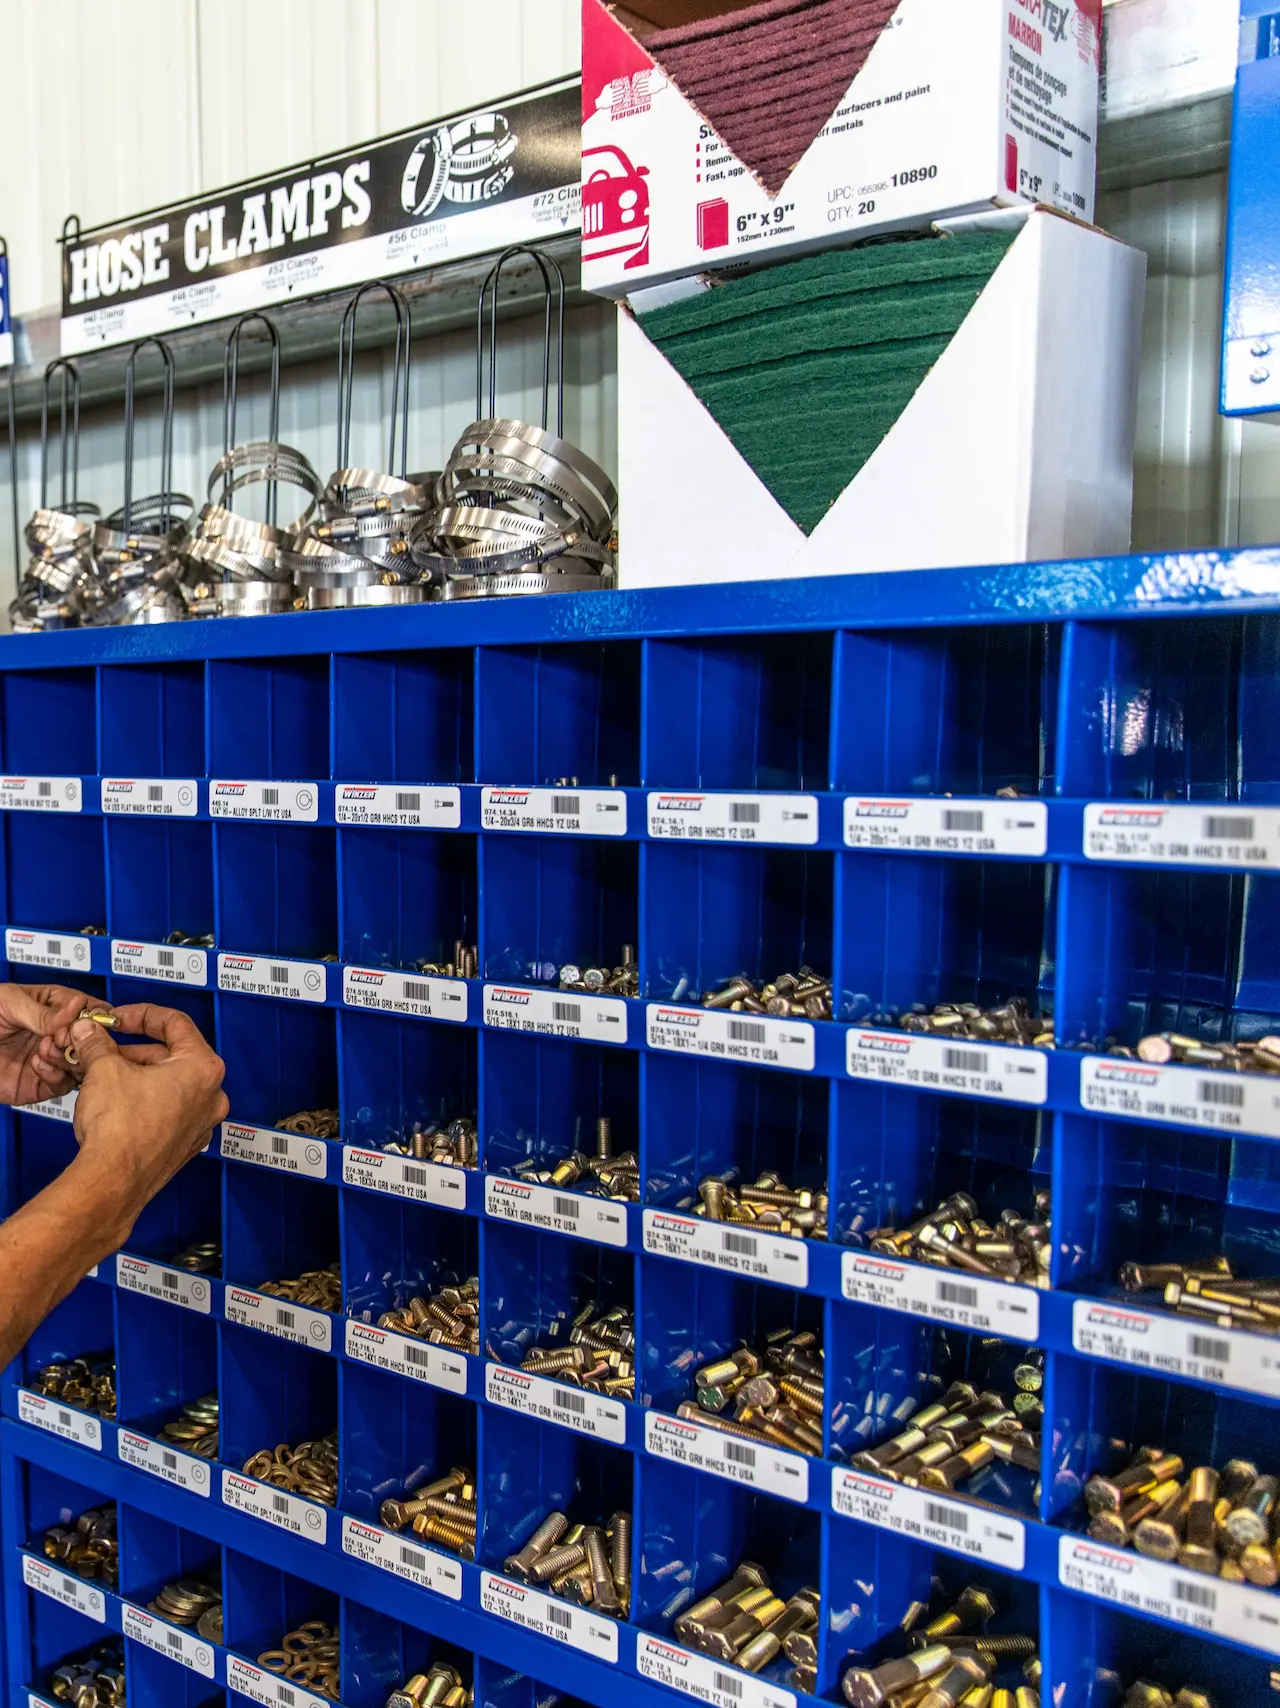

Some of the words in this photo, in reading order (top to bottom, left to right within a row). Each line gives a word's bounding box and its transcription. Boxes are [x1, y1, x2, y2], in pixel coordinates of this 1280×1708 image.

[1008, 11, 1042, 56] MARRON
[836, 99, 882, 117] surfacers
[884, 92, 902, 104] and
[904, 84, 930, 100] paint
[610, 104, 652, 121] PERFORATED
[832, 119, 864, 134] metals
[706, 144, 718, 153] For
[706, 155, 736, 168] Remov
[706, 170, 726, 183] Fast,
[533, 193, 554, 208] #72
[828, 186, 854, 203] UPC:
[827, 206, 854, 222] QTY:
[858, 200, 875, 215] 20
[70, 222, 170, 304] HOSE
[184, 160, 371, 272] CLAMPS
[388, 230, 407, 244] #56
[411, 222, 446, 239] Clamp
[737, 232, 761, 244] 152mm
[770, 226, 795, 236] 230mm
[273, 808, 279, 818] YZ
[281, 809, 291, 818] USA
[370, 813, 381, 822] GR8
[382, 813, 398, 823] HHCS
[399, 814, 406, 823] YZ
[408, 814, 420, 824] USA
[484, 808, 516, 816] 074.14.34
[521, 817, 534, 827] GR8
[536, 817, 553, 828] HHCS
[555, 818, 564, 828] YZ
[566, 818, 579, 829] USA
[281, 986, 288, 996] YZ
[289, 987, 299, 997] USA
[345, 986, 376, 997] 074.516.34
[381, 999, 391, 1009] GR8
[394, 1000, 409, 1011] HHCS
[410, 1003, 418, 1013] YZ
[420, 1004, 431, 1015] USA
[486, 1008, 517, 1018] 074.516.1
[522, 1020, 534, 1031] GR8
[536, 1022, 553, 1034] HHCS
[556, 1024, 564, 1035] YZ
[566, 1026, 579, 1037] USA
[762, 1048, 778, 1060] USA
[345, 1165, 372, 1177] 074.38.34
[377, 1179, 388, 1190] GR8
[390, 1182, 405, 1194] HHCS
[406, 1186, 413, 1196] YZ
[415, 1188, 427, 1200] USA
[487, 1195, 515, 1207] 074.38.1
[520, 1210, 532, 1221] GR8
[534, 1213, 550, 1226] HHCS
[552, 1217, 560, 1228] YZ
[563, 1219, 576, 1232] USA
[347, 1338, 374, 1353] 074.716.1
[377, 1355, 388, 1367] GR8
[390, 1359, 404, 1373] HHCS
[406, 1364, 413, 1376] YZ
[415, 1368, 426, 1380] USA
[488, 1381, 527, 1399] 074.716.112
[538, 1404, 550, 1417] GR8
[552, 1408, 569, 1423] HHCS
[571, 1415, 579, 1426] YZ
[582, 1418, 595, 1431] USA
[738, 1467, 753, 1481] USA
[283, 1516, 289, 1527] YZ
[290, 1519, 300, 1532] USA
[344, 1535, 374, 1553] 074.12.112
[383, 1558, 394, 1571] GR8
[395, 1563, 410, 1578] HHCS
[411, 1570, 418, 1581] YZ
[420, 1573, 431, 1587] USA
[483, 1591, 510, 1608] 074.12.2
[513, 1610, 525, 1624] GR8
[527, 1616, 543, 1632] HHCS
[545, 1623, 553, 1636] YZ
[555, 1627, 568, 1642] USA
